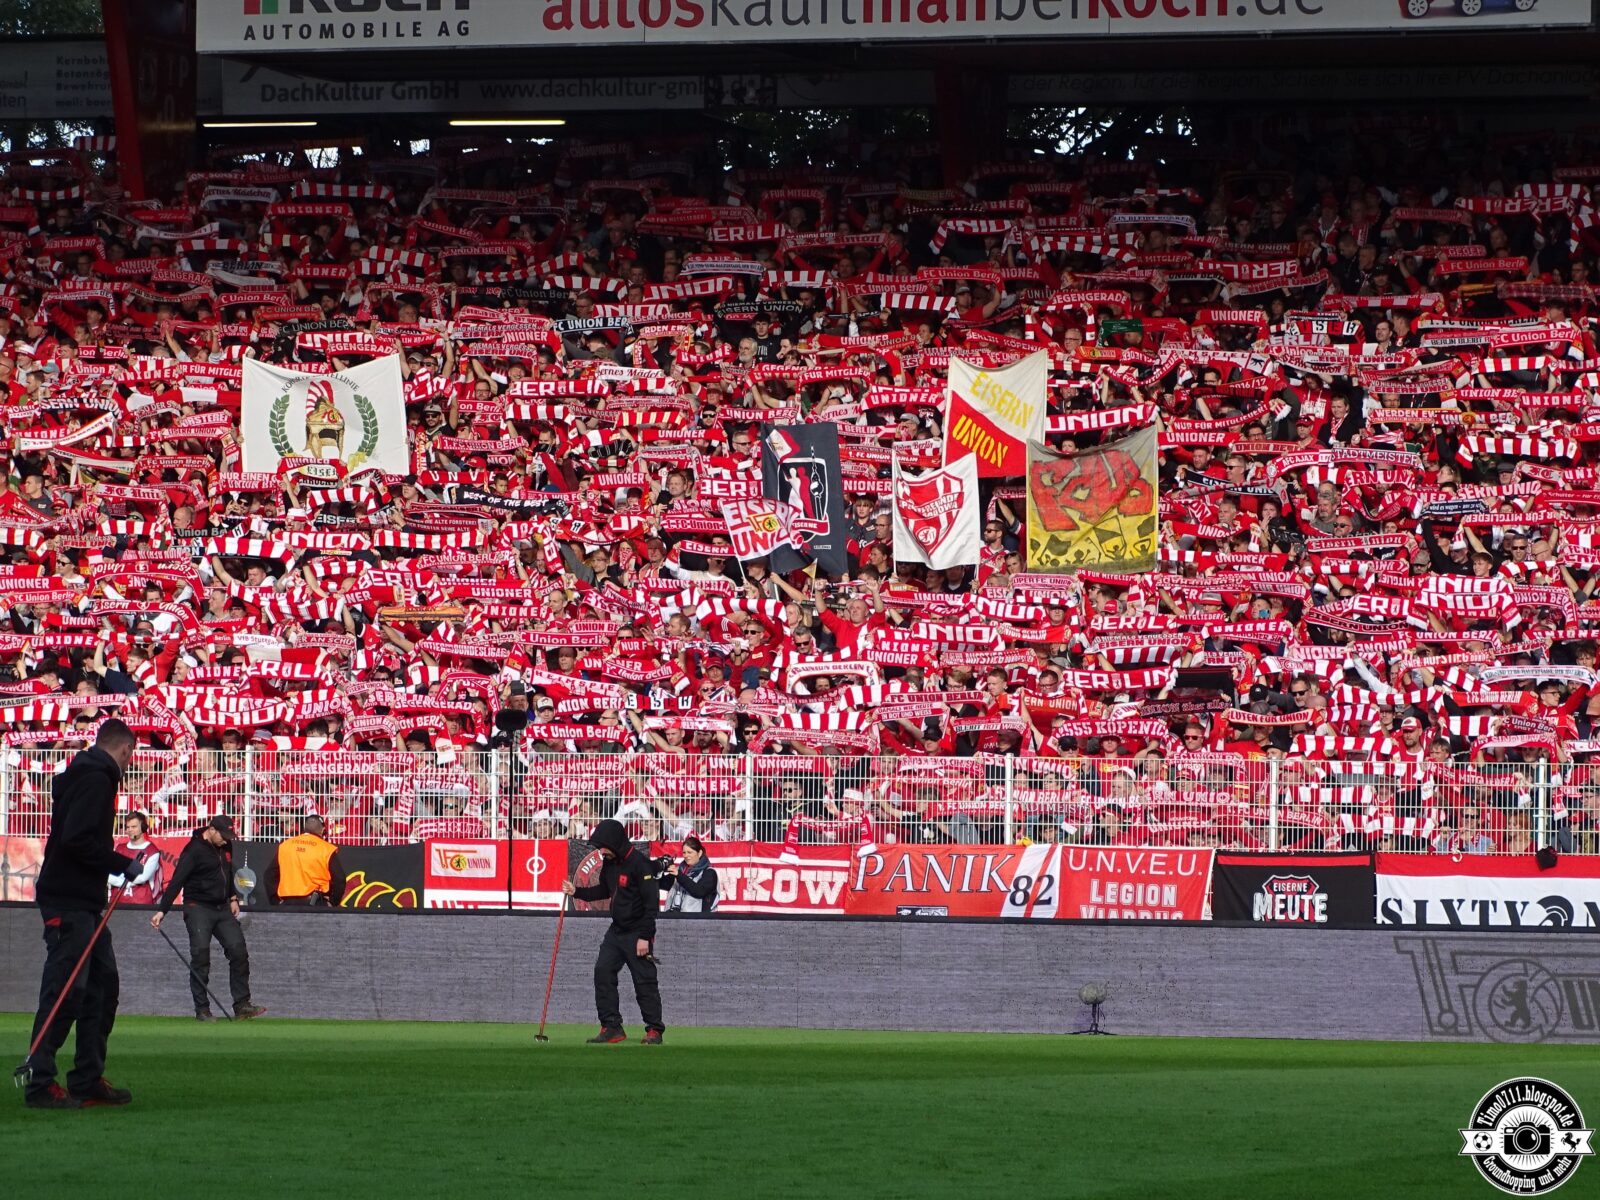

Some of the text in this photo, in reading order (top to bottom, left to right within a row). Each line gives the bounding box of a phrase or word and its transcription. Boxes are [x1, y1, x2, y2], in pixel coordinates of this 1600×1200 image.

[244, 20, 470, 41] AUTOMOBILE AG
[261, 79, 460, 103] DachKultur GmbH
[480, 75, 765, 101] www.dachkultur-gm.d
[1450, 260, 1495, 270] FC Union
[923, 269, 970, 278] FC Union
[854, 283, 928, 292] FC Union Berlin
[230, 294, 260, 302] Union
[1211, 310, 1261, 322] UNIONER
[292, 322, 328, 332] UNION
[568, 320, 604, 330] UNION
[1512, 331, 1546, 340] Union
[76, 366, 107, 374] Union
[190, 364, 207, 374] FÜR
[512, 380, 595, 398] BERLIN
[1462, 389, 1500, 397] UNION
[870, 394, 936, 404] UNIONER
[970, 371, 1035, 428] EISERN
[1048, 405, 1144, 431] UNION
[194, 427, 216, 435] UNION
[658, 430, 704, 438] UNIONER
[952, 414, 1008, 468] UNION
[1167, 433, 1224, 442] UNIONER
[1282, 455, 1313, 466] AFC AJAX
[1332, 448, 1417, 464] STADTMEISTER
[220, 472, 268, 481] NUR EINEN
[599, 474, 644, 484] UNIONER
[523, 498, 548, 508] BEST
[178, 527, 209, 536] Union
[686, 541, 728, 553] EISERN
[1311, 538, 1355, 548] Eisern
[1, 578, 49, 589] UNIONER
[649, 579, 690, 589] UNION
[472, 588, 531, 597] UNIONER
[1515, 594, 1546, 602] UNION
[160, 603, 189, 618] Union
[576, 623, 605, 631] UNION
[1214, 623, 1286, 632] UNIONER
[1362, 622, 1408, 631] UNION
[481, 633, 514, 641] Union
[530, 635, 562, 644] Union
[914, 625, 1000, 644] UNION
[1462, 631, 1500, 646] BERLIN
[621, 641, 640, 650] NUR
[1099, 638, 1189, 648] EISERN UNION
[868, 650, 918, 664] UNIONER
[1064, 668, 1169, 688] BERLIN
[57, 696, 86, 704] UNION
[89, 694, 125, 702] BERLIN
[1050, 698, 1077, 710] UNION
[1279, 711, 1309, 722] UNION
[1512, 718, 1535, 727] Union
[9, 732, 50, 740] UNION
[533, 726, 620, 739] FC Union Berlin
[286, 764, 375, 774] GEGENGERADE
[758, 758, 812, 770] UNIONER
[546, 777, 591, 788] FC Union
[657, 778, 729, 790] UNIONER
[581, 856, 597, 874] DIE
[1069, 850, 1202, 876] U.N.V.E.U.
[851, 853, 1054, 906] PANIK 82
[1273, 882, 1308, 892] EISERNE
[1090, 879, 1177, 907] LEGION
[1253, 893, 1328, 922] MEUTE
